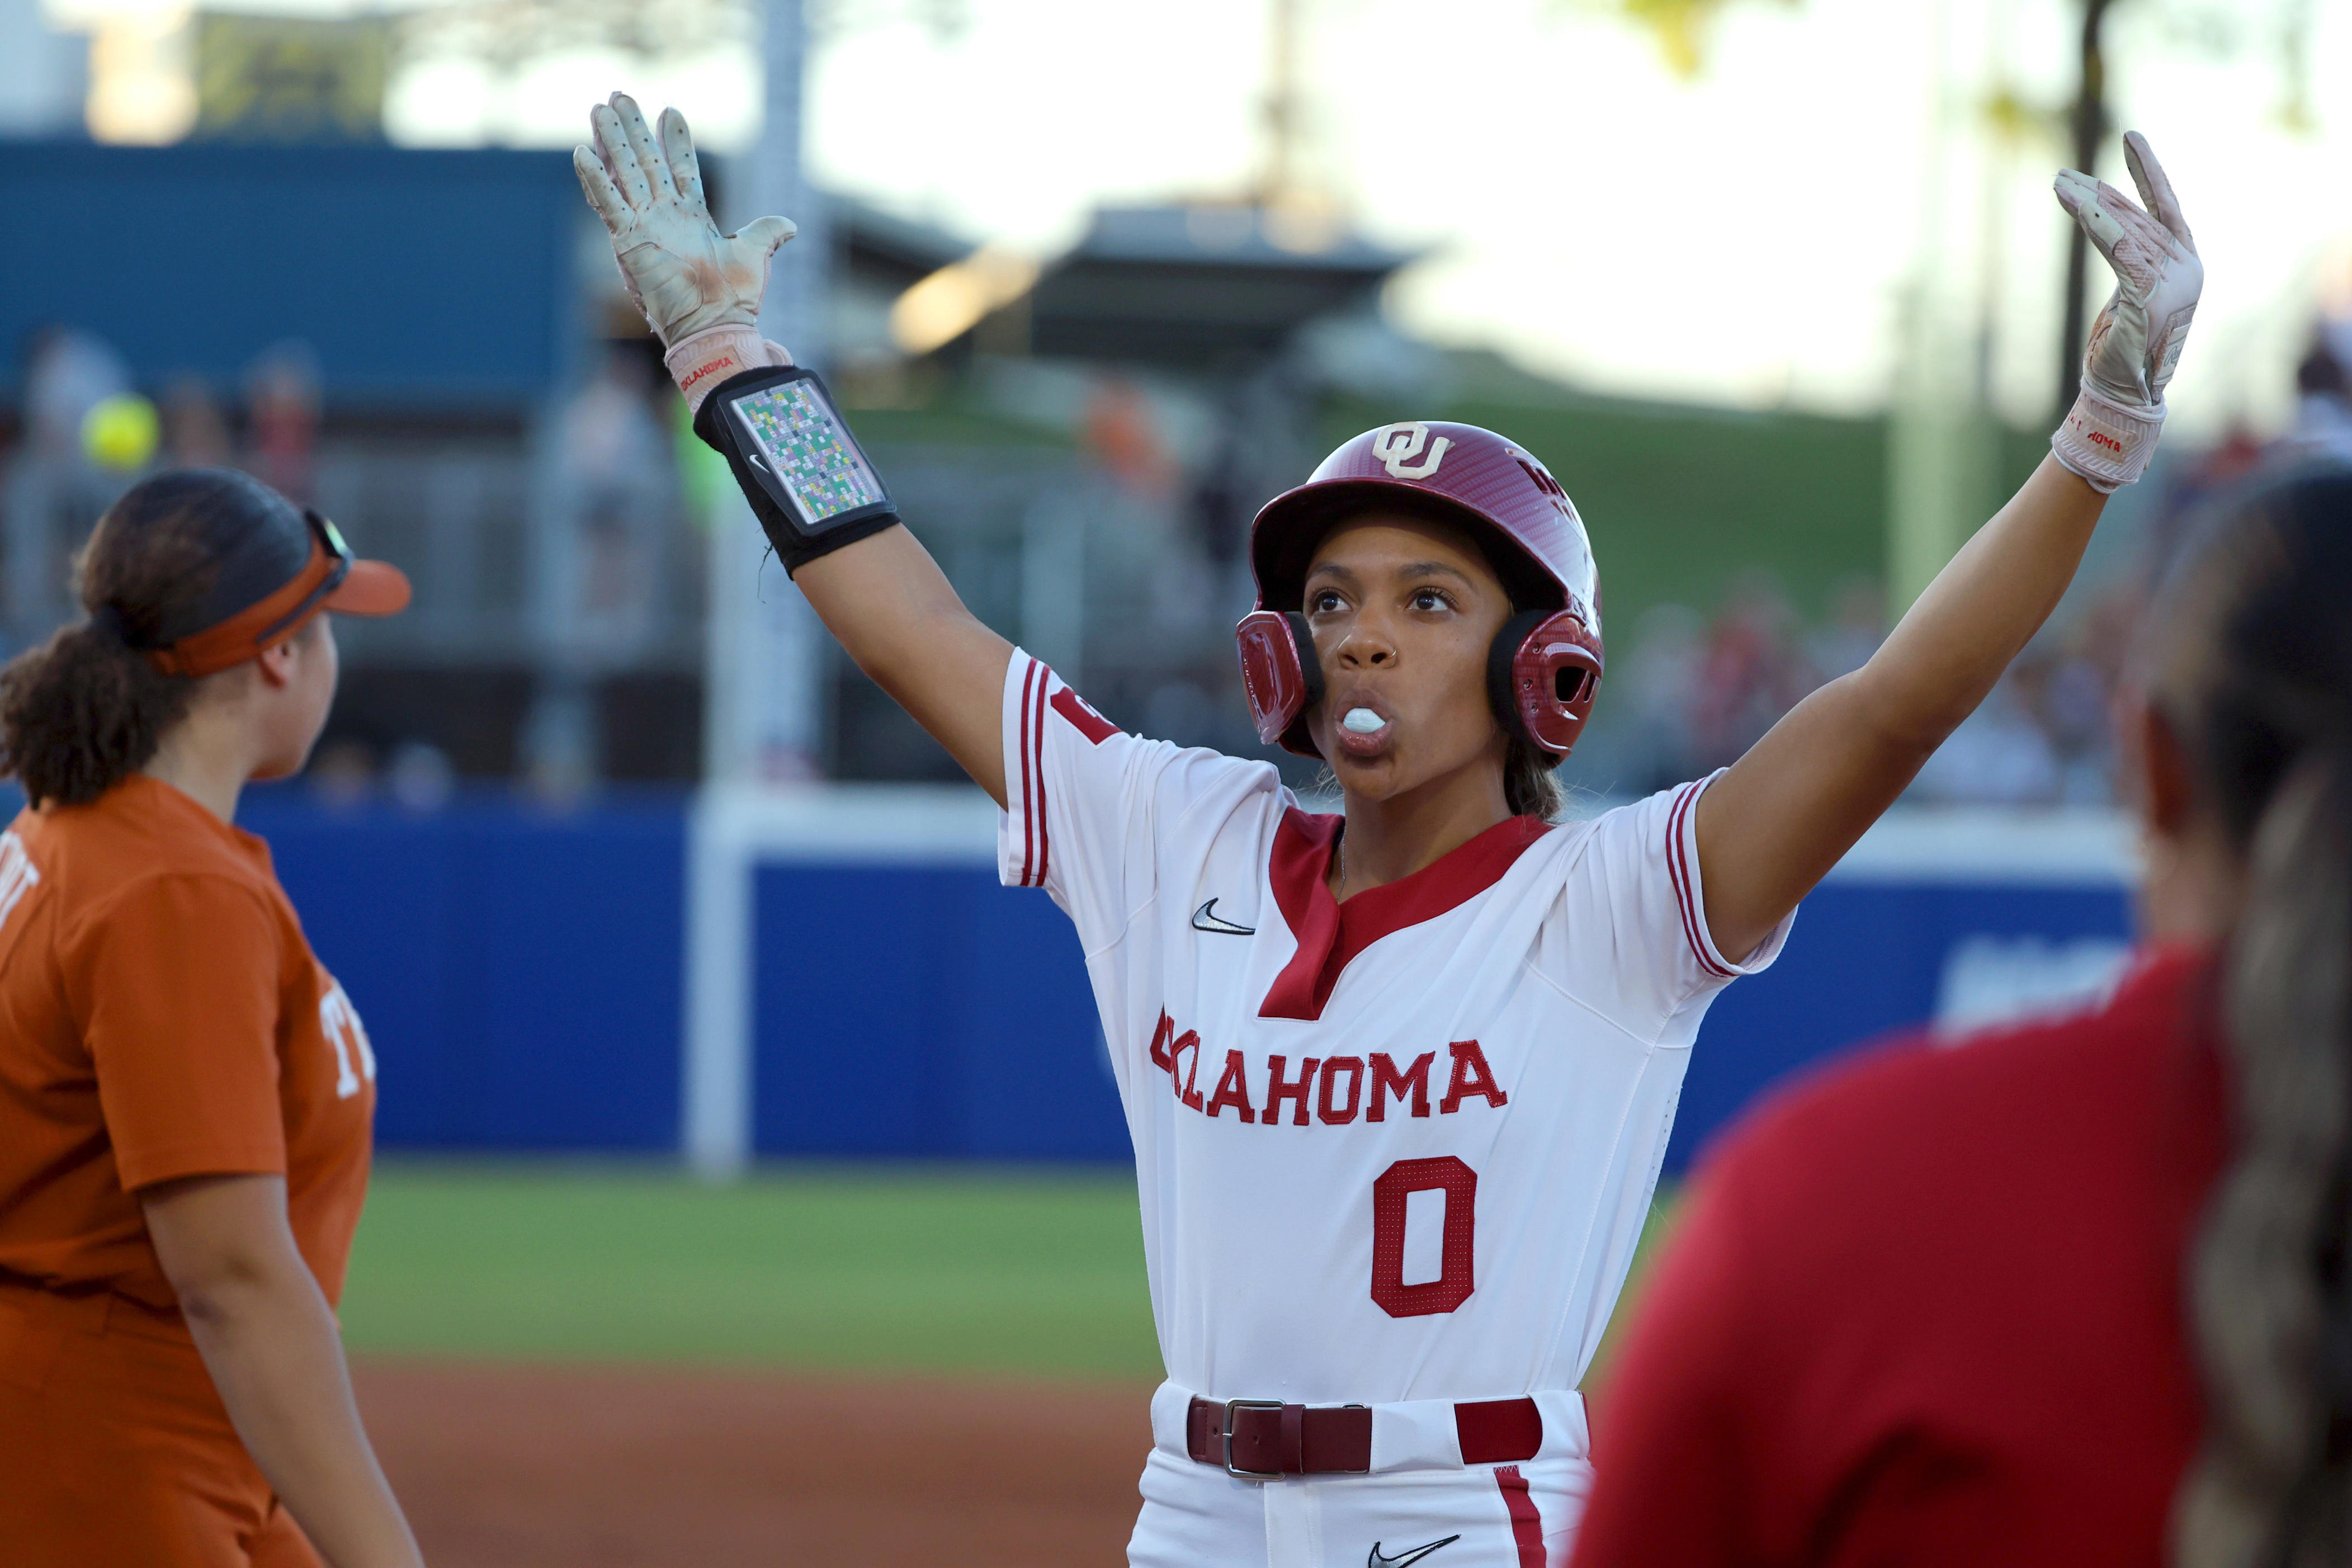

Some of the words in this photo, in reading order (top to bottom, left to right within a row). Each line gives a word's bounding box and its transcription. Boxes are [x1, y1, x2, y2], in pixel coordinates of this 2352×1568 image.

[681, 356, 734, 391] OKLAHOMA
[1372, 421, 1451, 480] OU
[1371, 1155, 1478, 1318] 0
